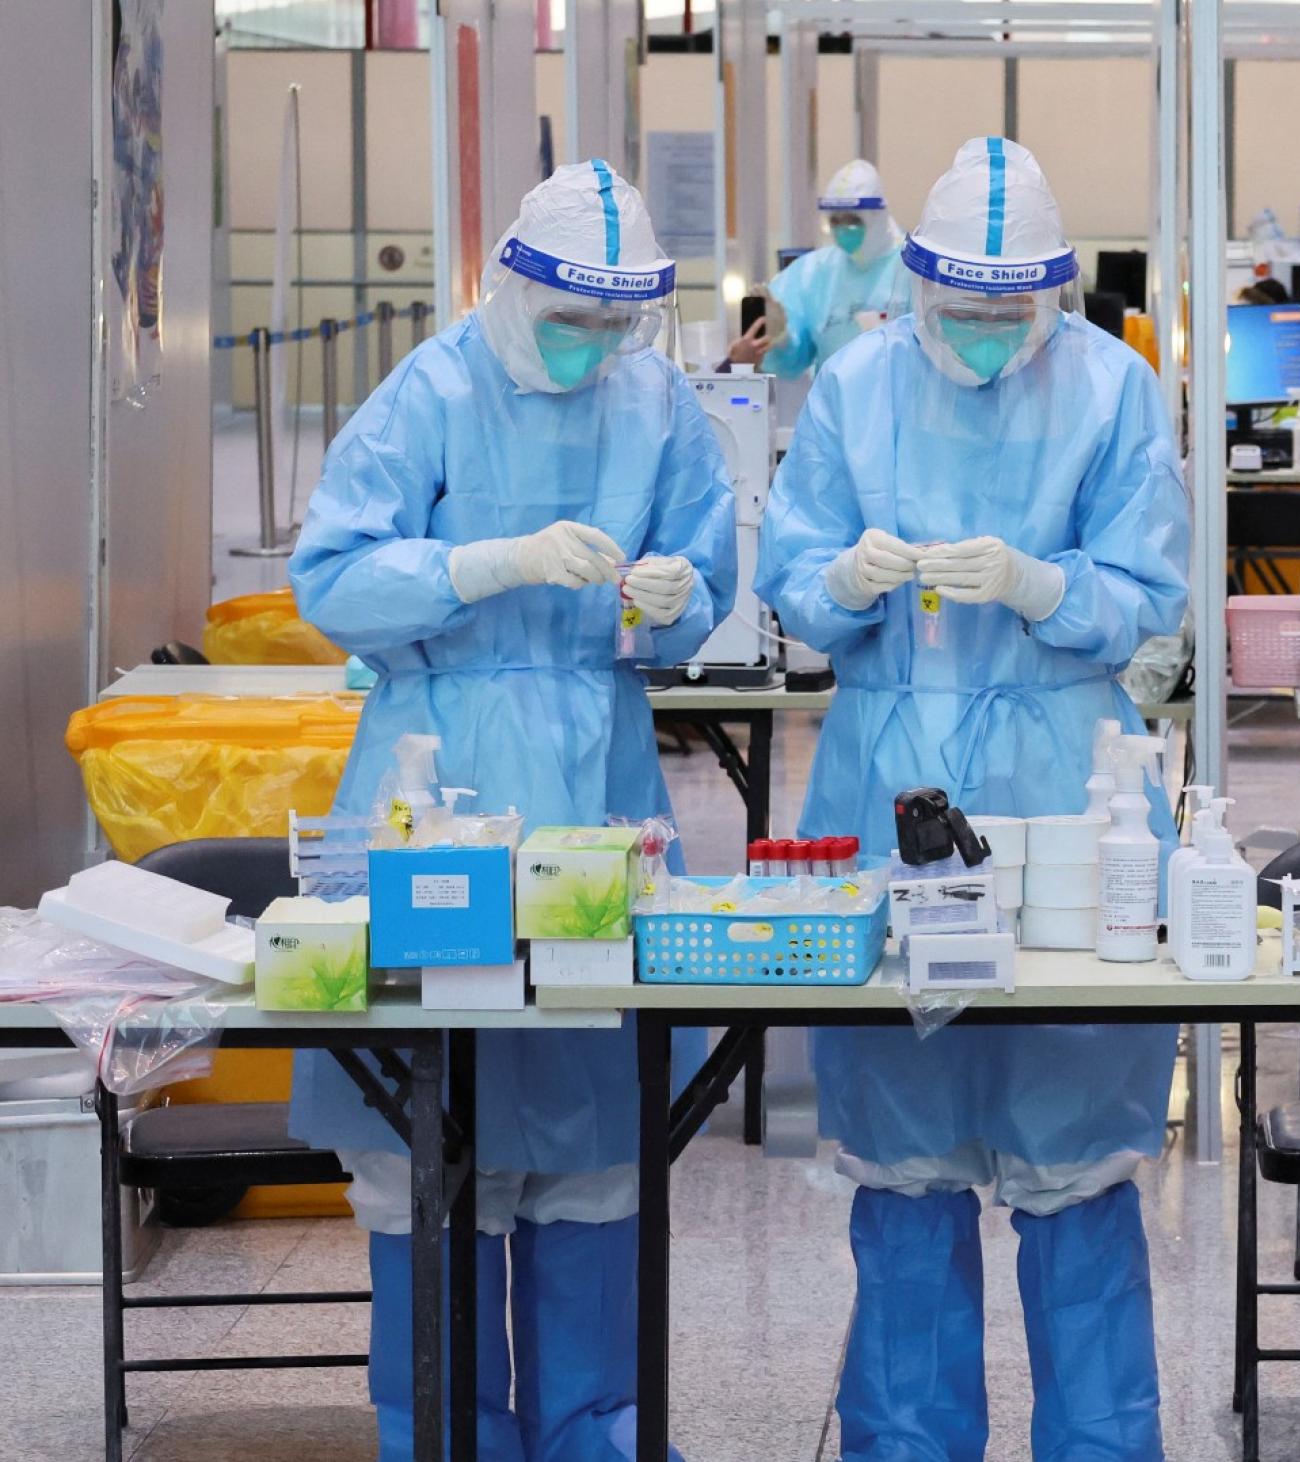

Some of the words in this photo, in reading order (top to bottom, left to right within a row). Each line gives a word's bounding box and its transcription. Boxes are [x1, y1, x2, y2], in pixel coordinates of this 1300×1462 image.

[567, 267, 605, 285] Face
[611, 275, 654, 288] Shield
[947, 263, 984, 279] Face
[991, 268, 1038, 280] Shield
